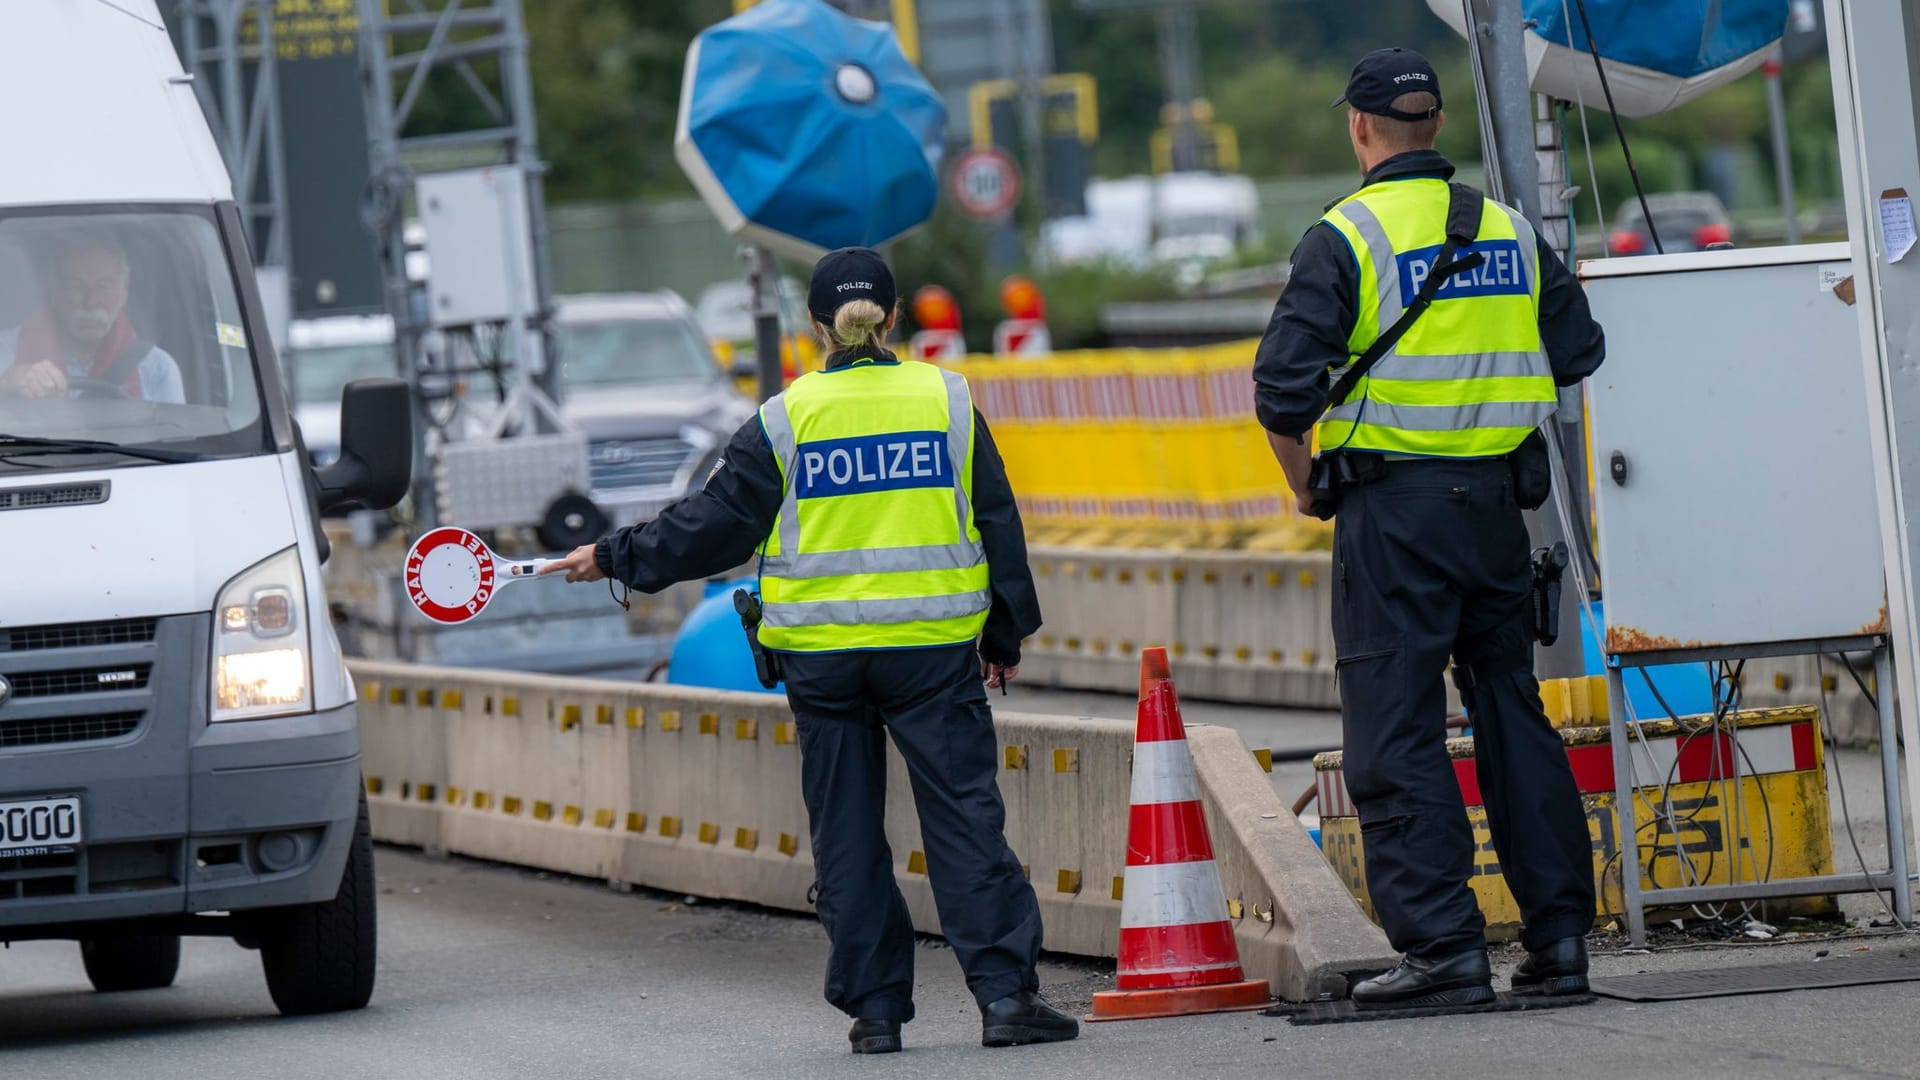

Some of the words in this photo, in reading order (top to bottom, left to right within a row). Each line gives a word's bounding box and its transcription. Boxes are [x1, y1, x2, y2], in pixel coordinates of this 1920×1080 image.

[1393, 73, 1429, 84] POLIZEI
[836, 281, 872, 293] POLIZEI
[804, 441, 941, 488] POLIZEI
[408, 550, 428, 606] HALT
[460, 533, 493, 614] POLIZEI
